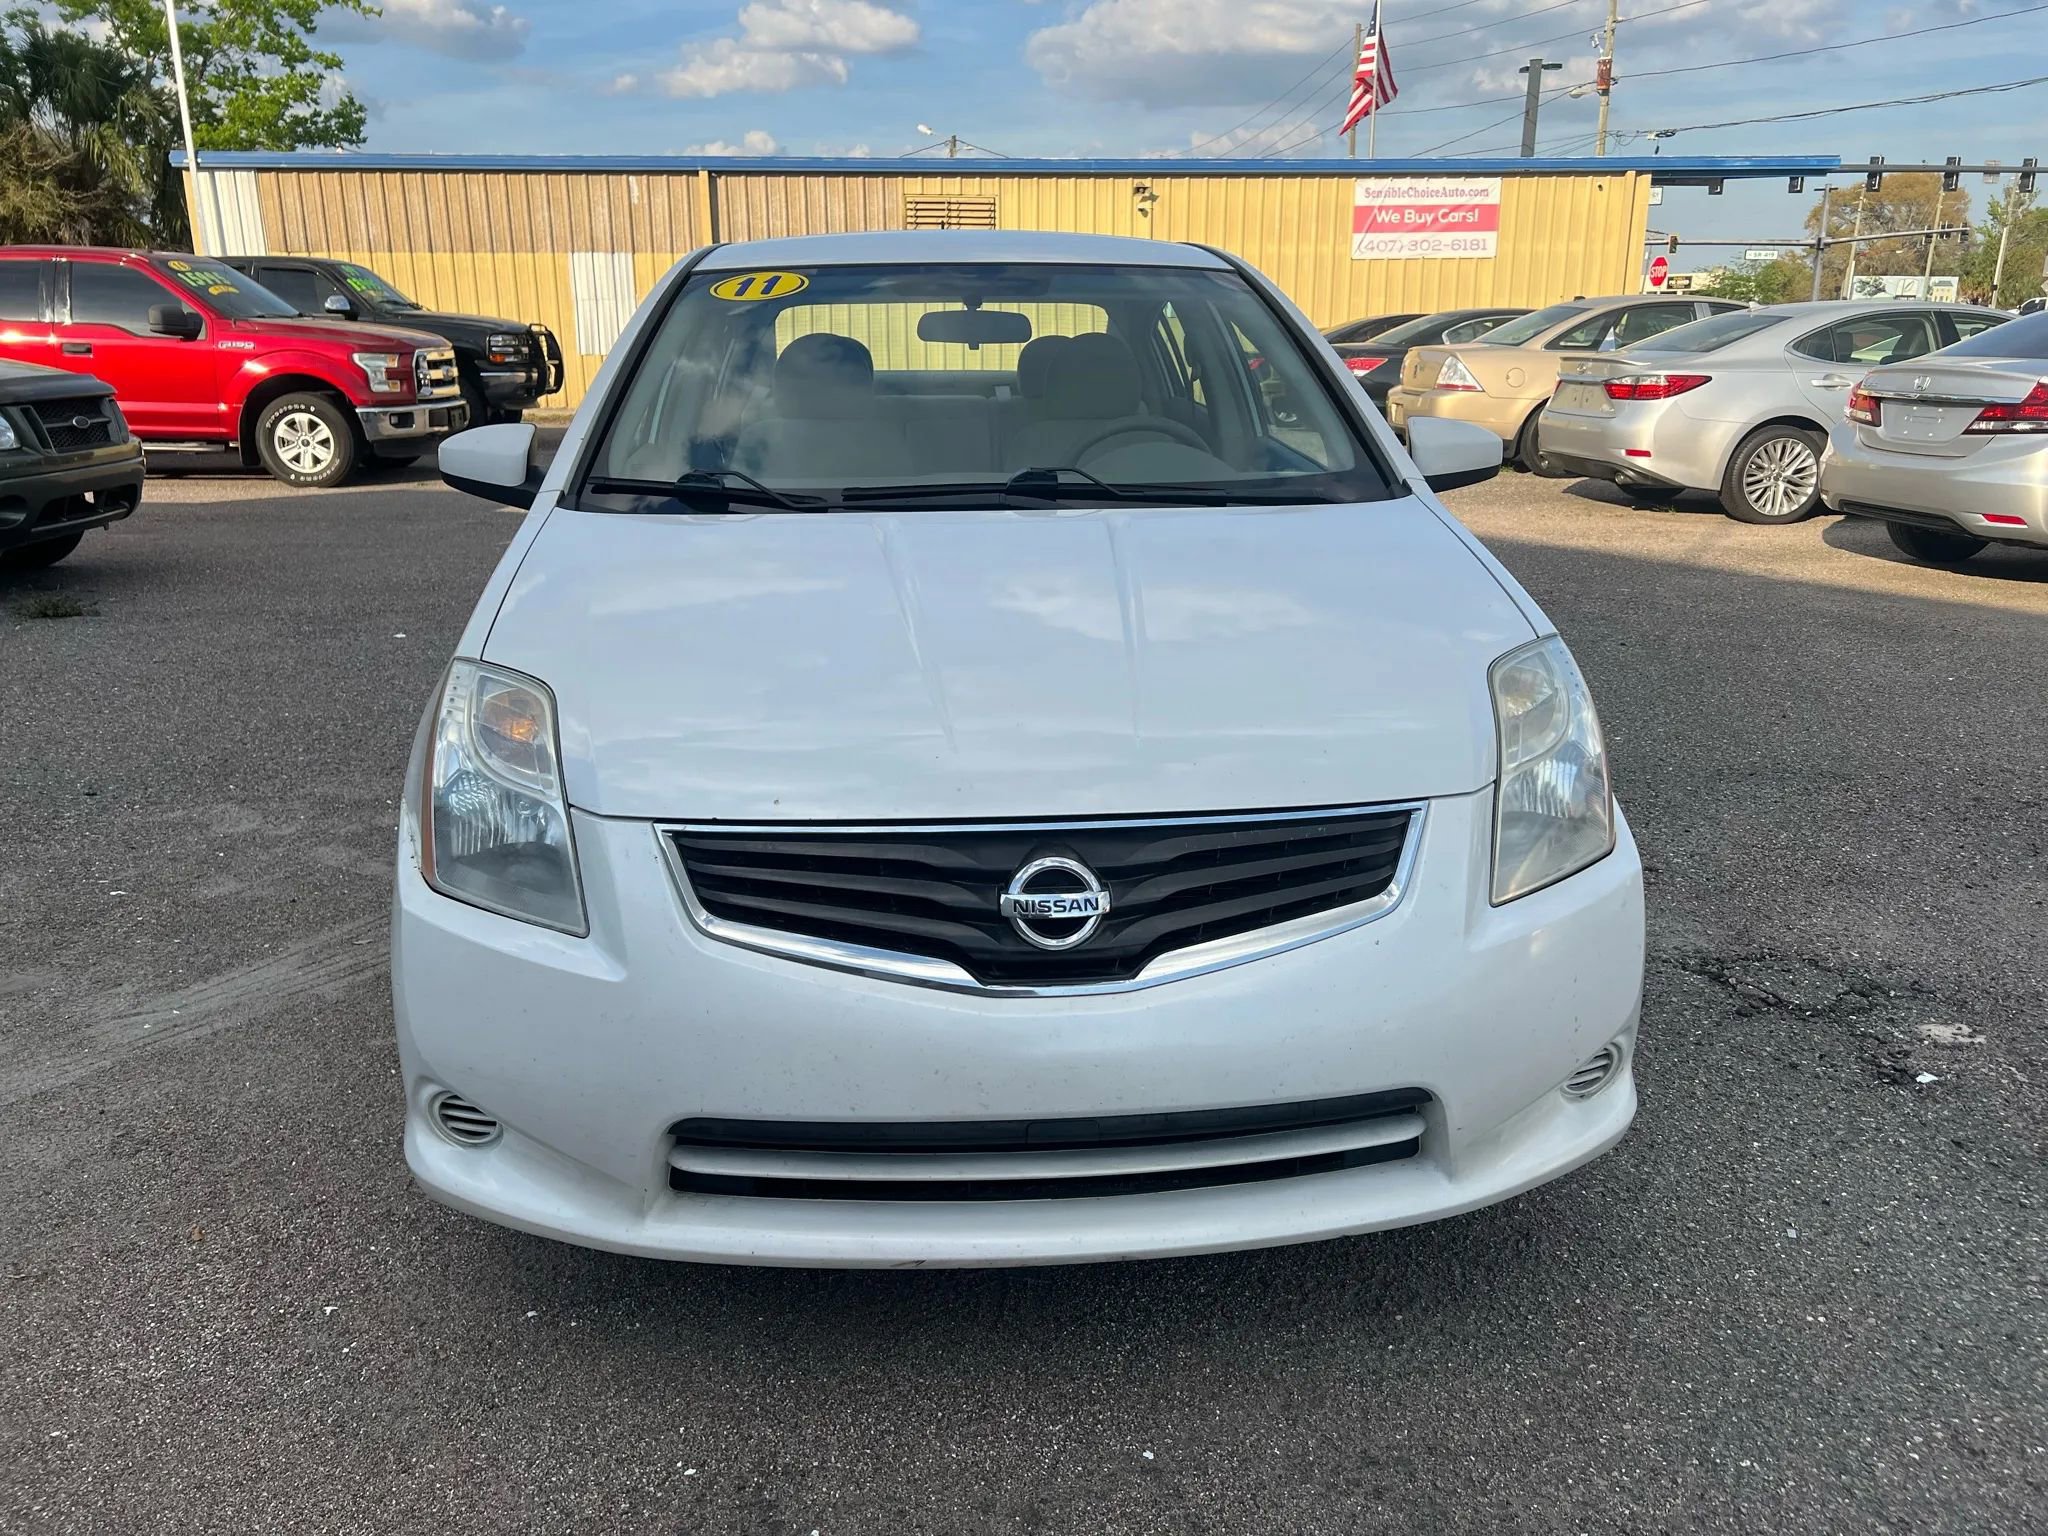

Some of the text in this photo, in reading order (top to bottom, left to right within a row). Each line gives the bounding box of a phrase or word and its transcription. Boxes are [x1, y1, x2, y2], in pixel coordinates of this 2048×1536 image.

[1375, 208, 1480, 226] We Buy Cars!
[1358, 238, 1488, 254] (407) 302-6181
[1650, 265, 1668, 278] STOP
[734, 275, 782, 297] 11
[1013, 896, 1099, 914] NISSAN
